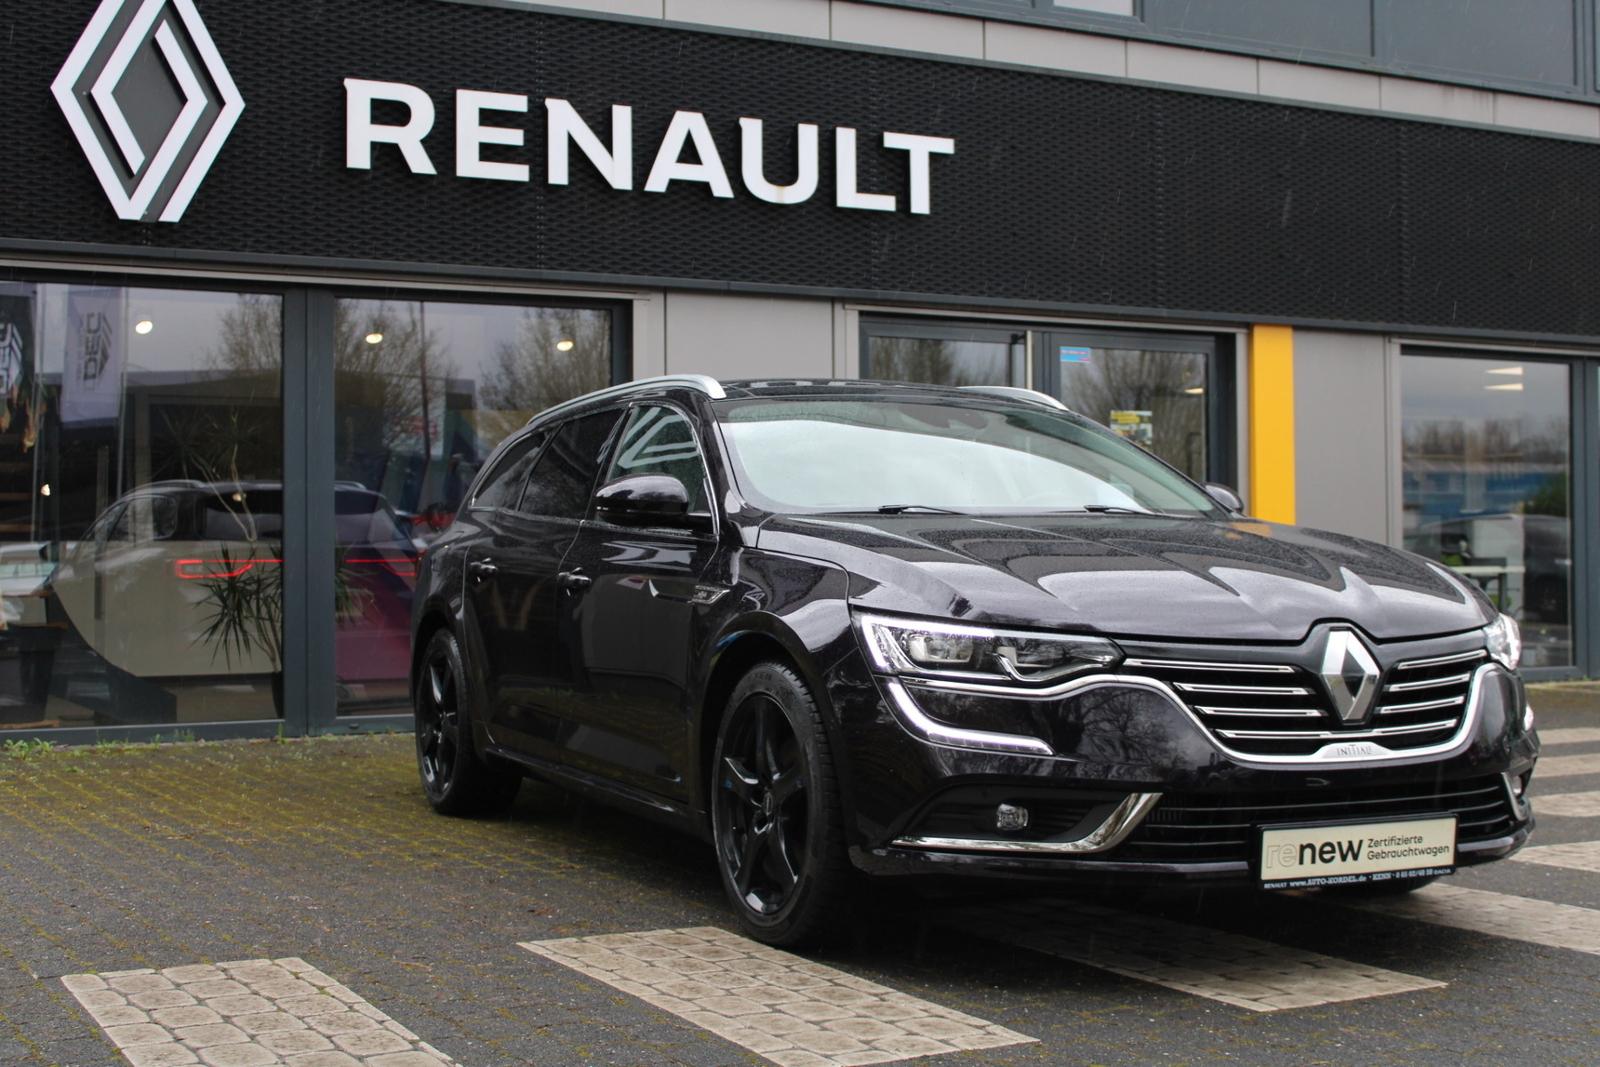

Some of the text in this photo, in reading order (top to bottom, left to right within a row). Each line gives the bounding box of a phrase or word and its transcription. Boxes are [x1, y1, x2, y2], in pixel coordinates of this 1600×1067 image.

[343, 77, 955, 216] RENAULT
[1367, 835, 1423, 848] Zertifizierte
[1265, 840, 1363, 868] renew
[1367, 845, 1450, 860] Gebrauchtwagen
